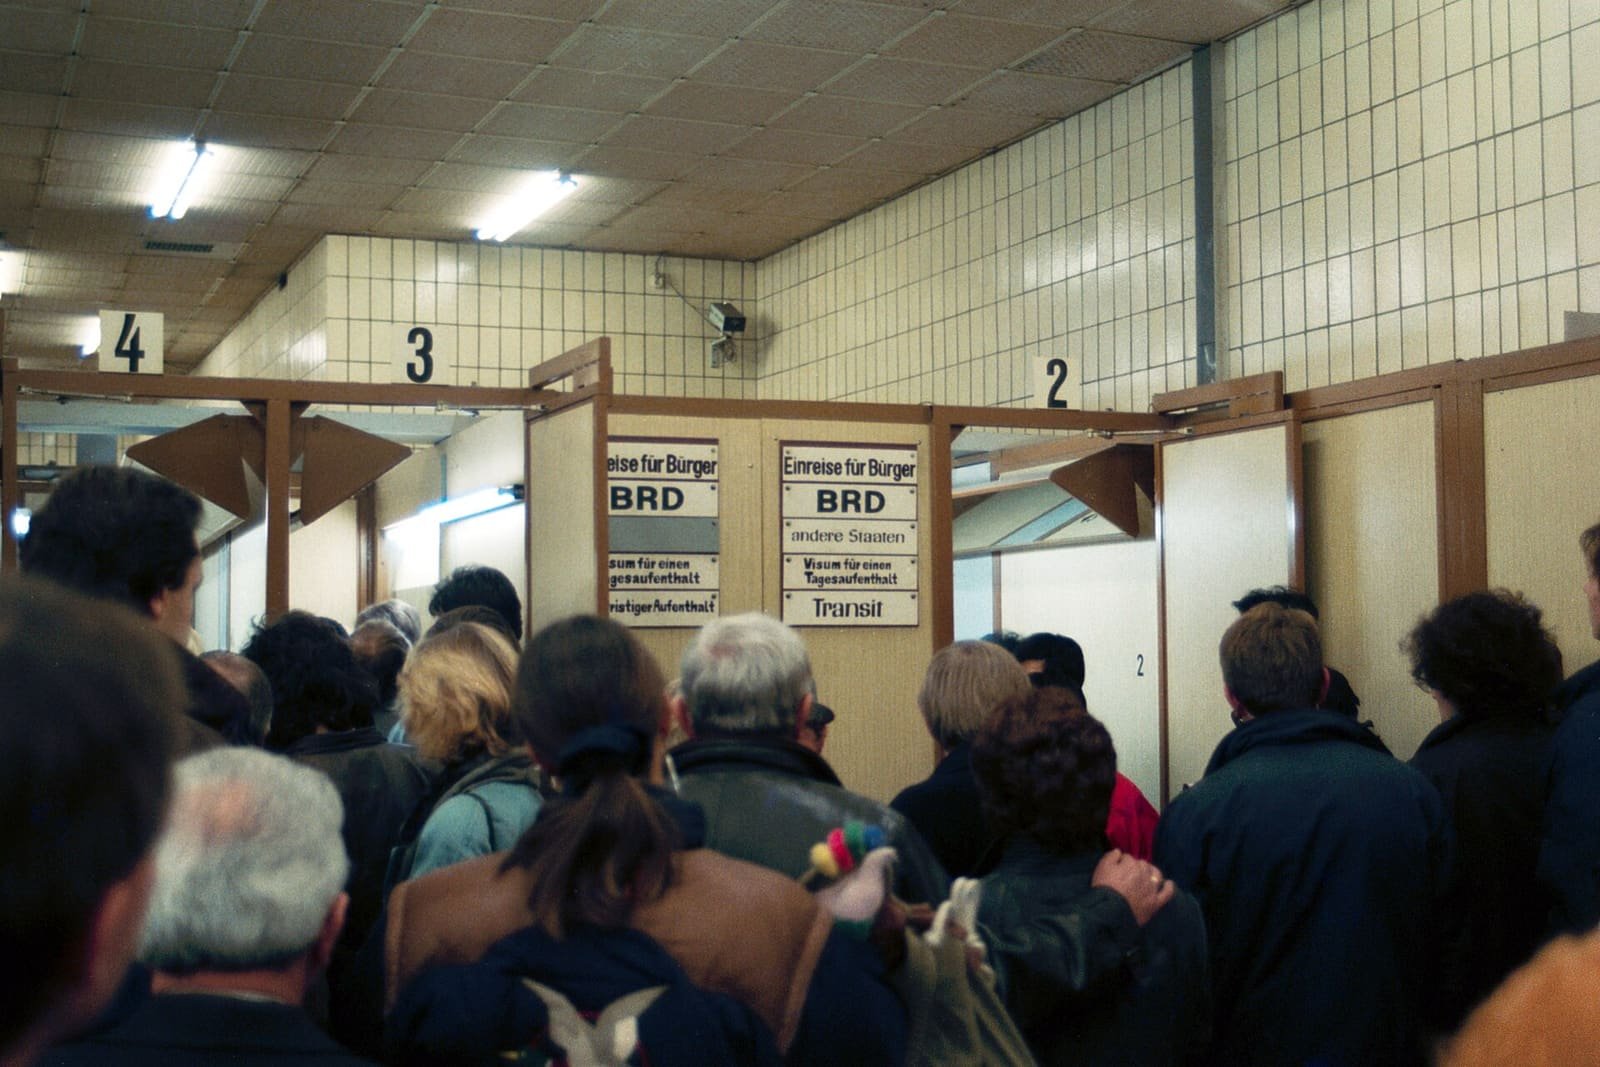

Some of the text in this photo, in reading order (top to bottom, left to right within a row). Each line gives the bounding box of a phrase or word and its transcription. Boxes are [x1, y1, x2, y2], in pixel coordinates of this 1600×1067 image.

[115, 313, 145, 372] 4
[407, 327, 433, 384] 3
[1047, 358, 1068, 408] 2
[607, 454, 718, 479] eise für Bürger
[784, 456, 916, 481] Einreise für Bürger
[610, 485, 685, 511] BRD
[816, 489, 886, 513] BRD
[791, 529, 905, 544] andere Staaten
[608, 558, 690, 569] sum für einen
[804, 558, 892, 570] Visum für einen
[608, 572, 700, 587] gesaufenthalt
[804, 571, 898, 588] Tagesaufenthalt
[609, 599, 715, 616] ristiger Aufenthalt
[813, 598, 883, 618] Transit
[1137, 653, 1144, 677] 2
